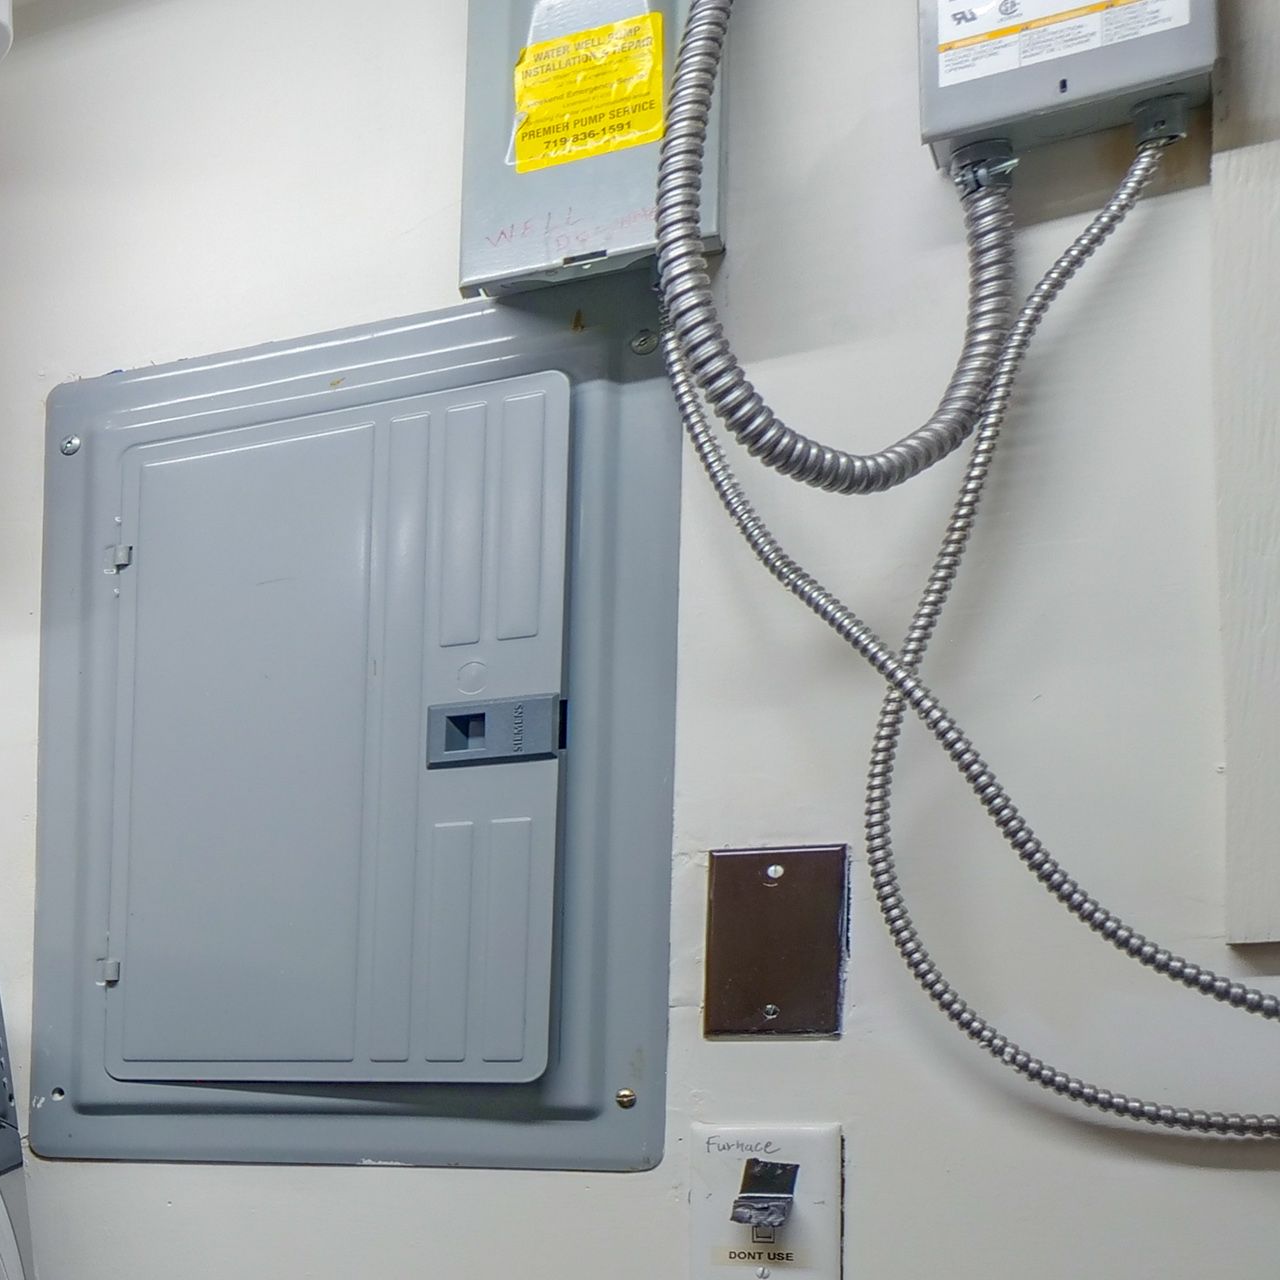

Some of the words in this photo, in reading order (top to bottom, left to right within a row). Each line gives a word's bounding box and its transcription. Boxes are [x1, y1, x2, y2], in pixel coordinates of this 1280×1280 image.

[533, 45, 570, 62] WATER
[574, 37, 602, 52] WELL
[521, 51, 598, 80] INSTALLATION
[521, 122, 570, 142] PREMIER
[573, 112, 606, 129] PUMP
[609, 100, 656, 120] SERVICE
[706, 1135, 782, 1154] Furnace
[728, 1251, 764, 1261] DONT
[767, 1251, 794, 1261] USE
